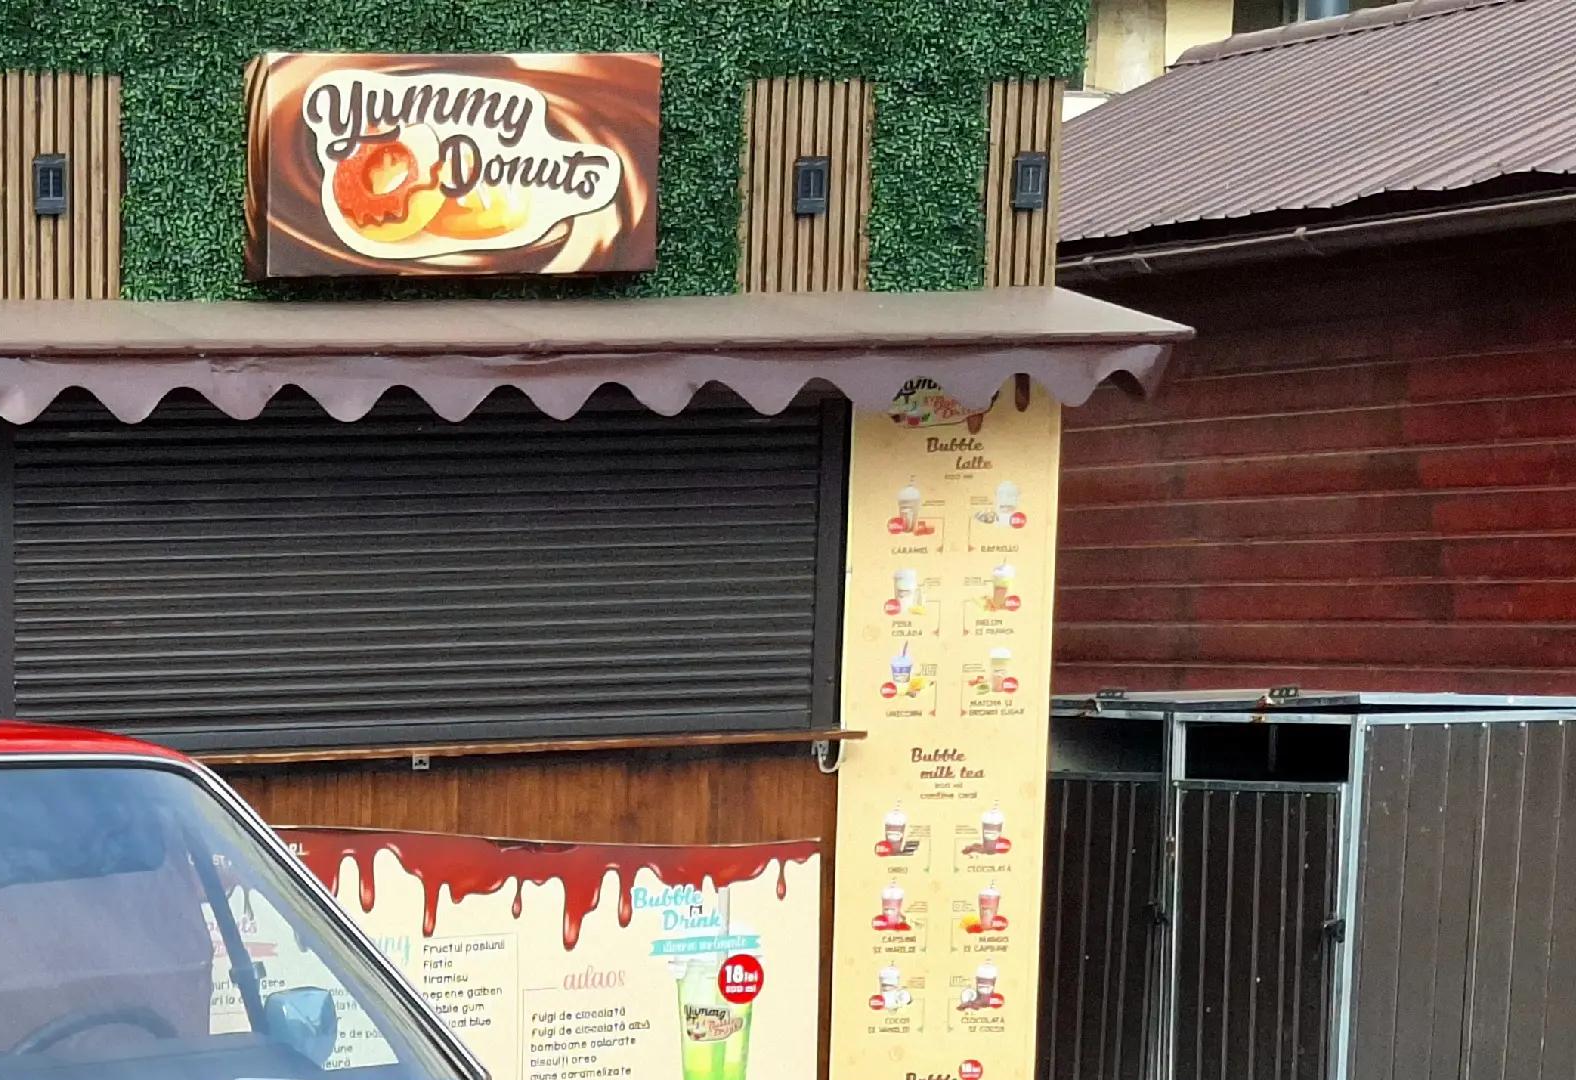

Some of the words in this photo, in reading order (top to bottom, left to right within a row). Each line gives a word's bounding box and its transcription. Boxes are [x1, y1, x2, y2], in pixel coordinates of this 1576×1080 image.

[307, 80, 532, 160] Yummy
[440, 134, 609, 199] Donuts
[927, 437, 984, 453] Bubble
[911, 747, 967, 763] Bubble
[919, 765, 955, 779] milk
[959, 766, 985, 779] tea
[633, 886, 704, 908] Bubble
[663, 909, 722, 931] Drink
[563, 965, 629, 990] adaos
[462, 1003, 485, 1014] gum
[531, 1011, 556, 1023] fulgi
[559, 1011, 572, 1021] de
[531, 1026, 556, 1038] fulgi
[559, 1026, 572, 1036] de
[572, 1056, 597, 1064] oreo
